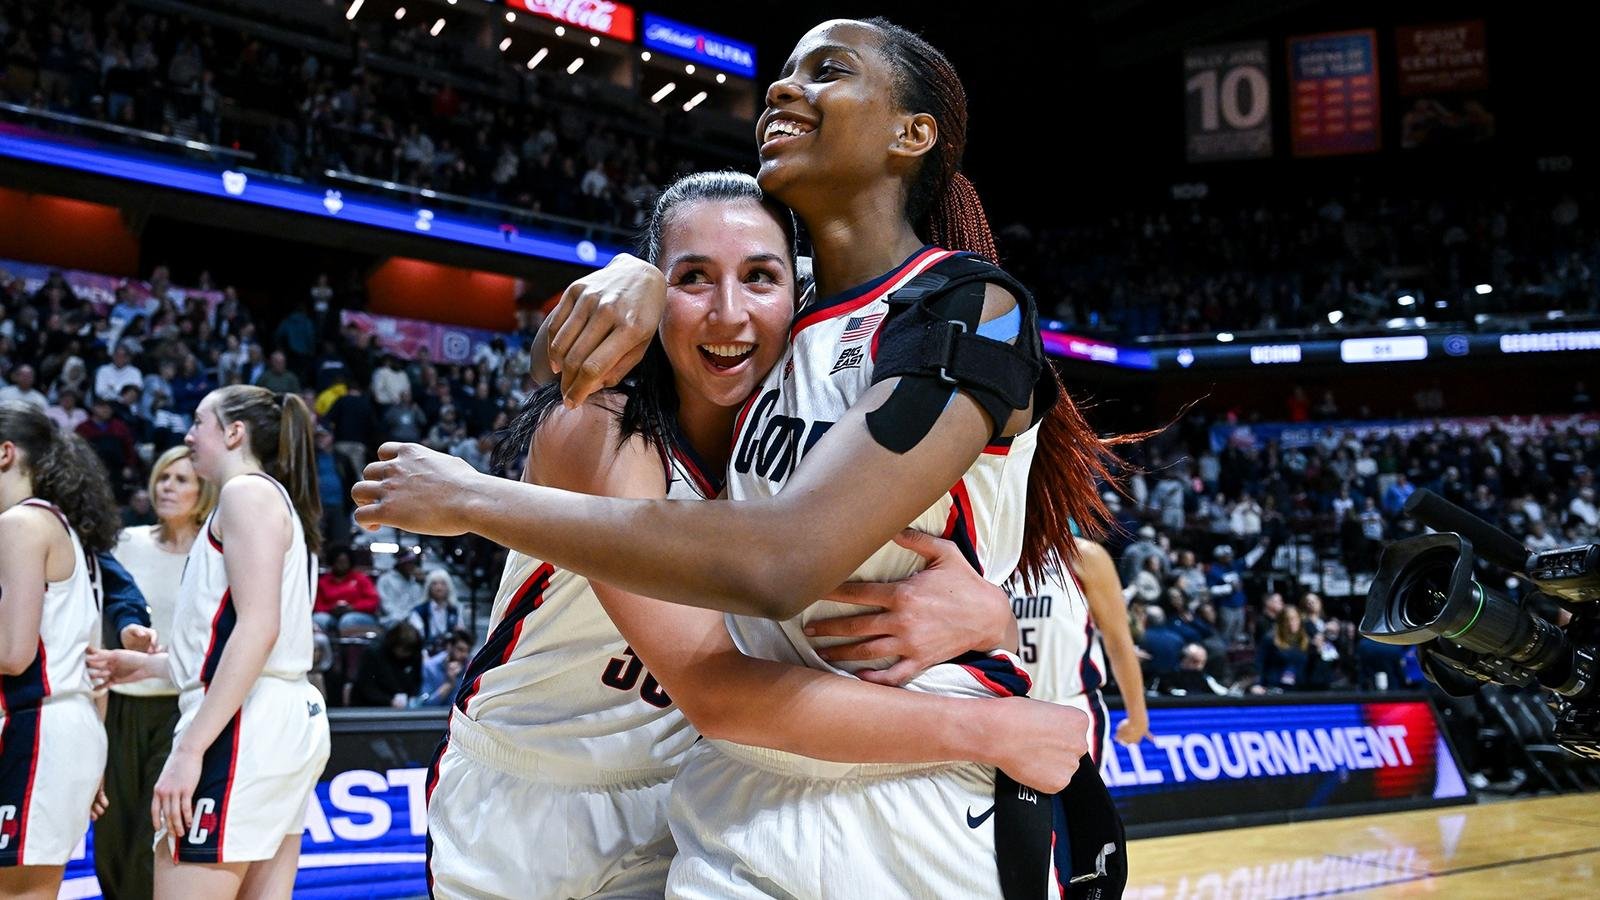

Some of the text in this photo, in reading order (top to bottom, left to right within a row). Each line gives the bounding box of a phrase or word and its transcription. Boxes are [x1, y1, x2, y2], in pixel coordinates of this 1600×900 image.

[1186, 65, 1270, 131] 10
[834, 353, 864, 370] EAST
[839, 345, 863, 361] BIG
[1154, 723, 1414, 782] TOURNAMENT
[188, 797, 216, 844] C
